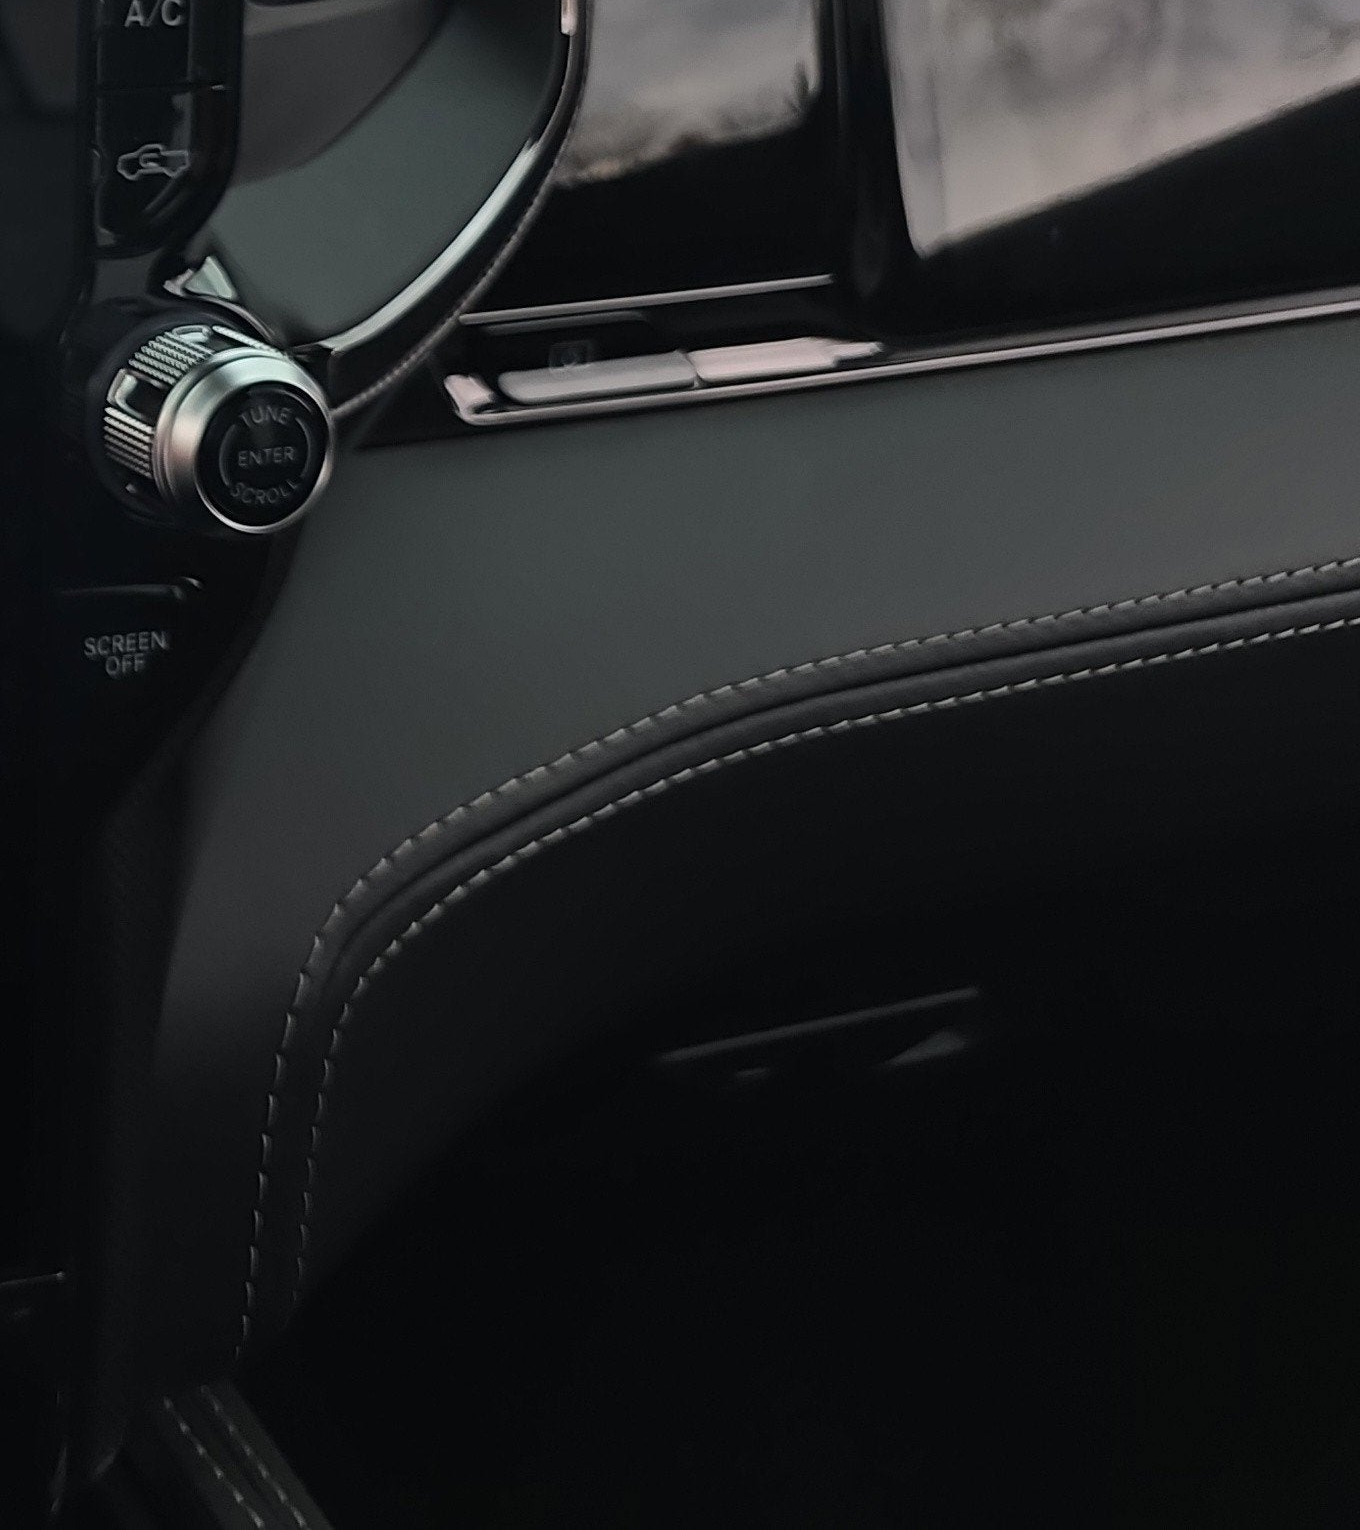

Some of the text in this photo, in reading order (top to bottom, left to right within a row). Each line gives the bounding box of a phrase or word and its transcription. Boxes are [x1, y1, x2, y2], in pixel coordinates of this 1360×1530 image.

[239, 404, 293, 429] TUNE
[238, 446, 296, 467] ENTER
[230, 476, 302, 505] SCROLL
[83, 630, 170, 658] SCREEN
[105, 652, 146, 679] OFF
